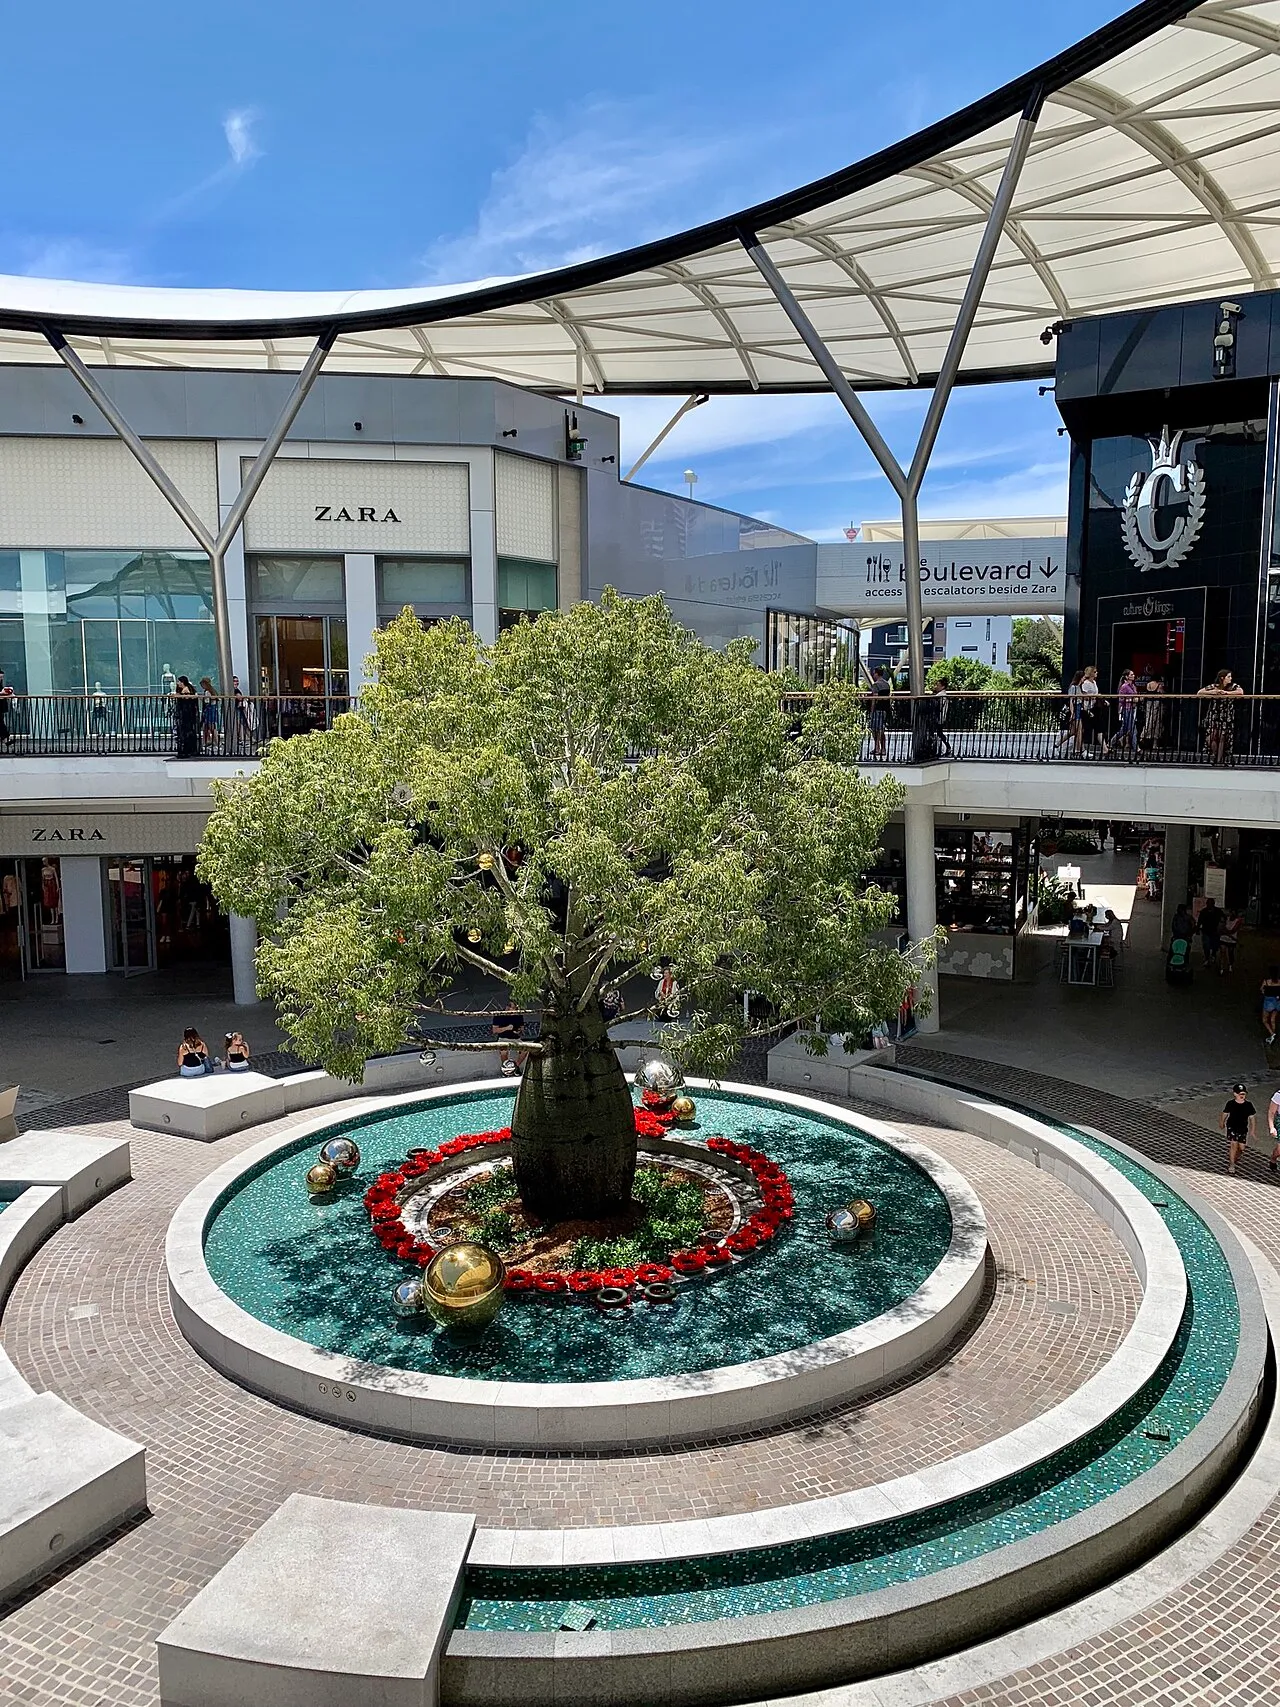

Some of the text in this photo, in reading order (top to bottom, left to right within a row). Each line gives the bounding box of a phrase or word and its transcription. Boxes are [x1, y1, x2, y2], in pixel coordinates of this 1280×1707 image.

[315, 506, 402, 522] ZARA
[865, 584, 1057, 597] access escalators beside Zara
[32, 828, 107, 841] ZARA
